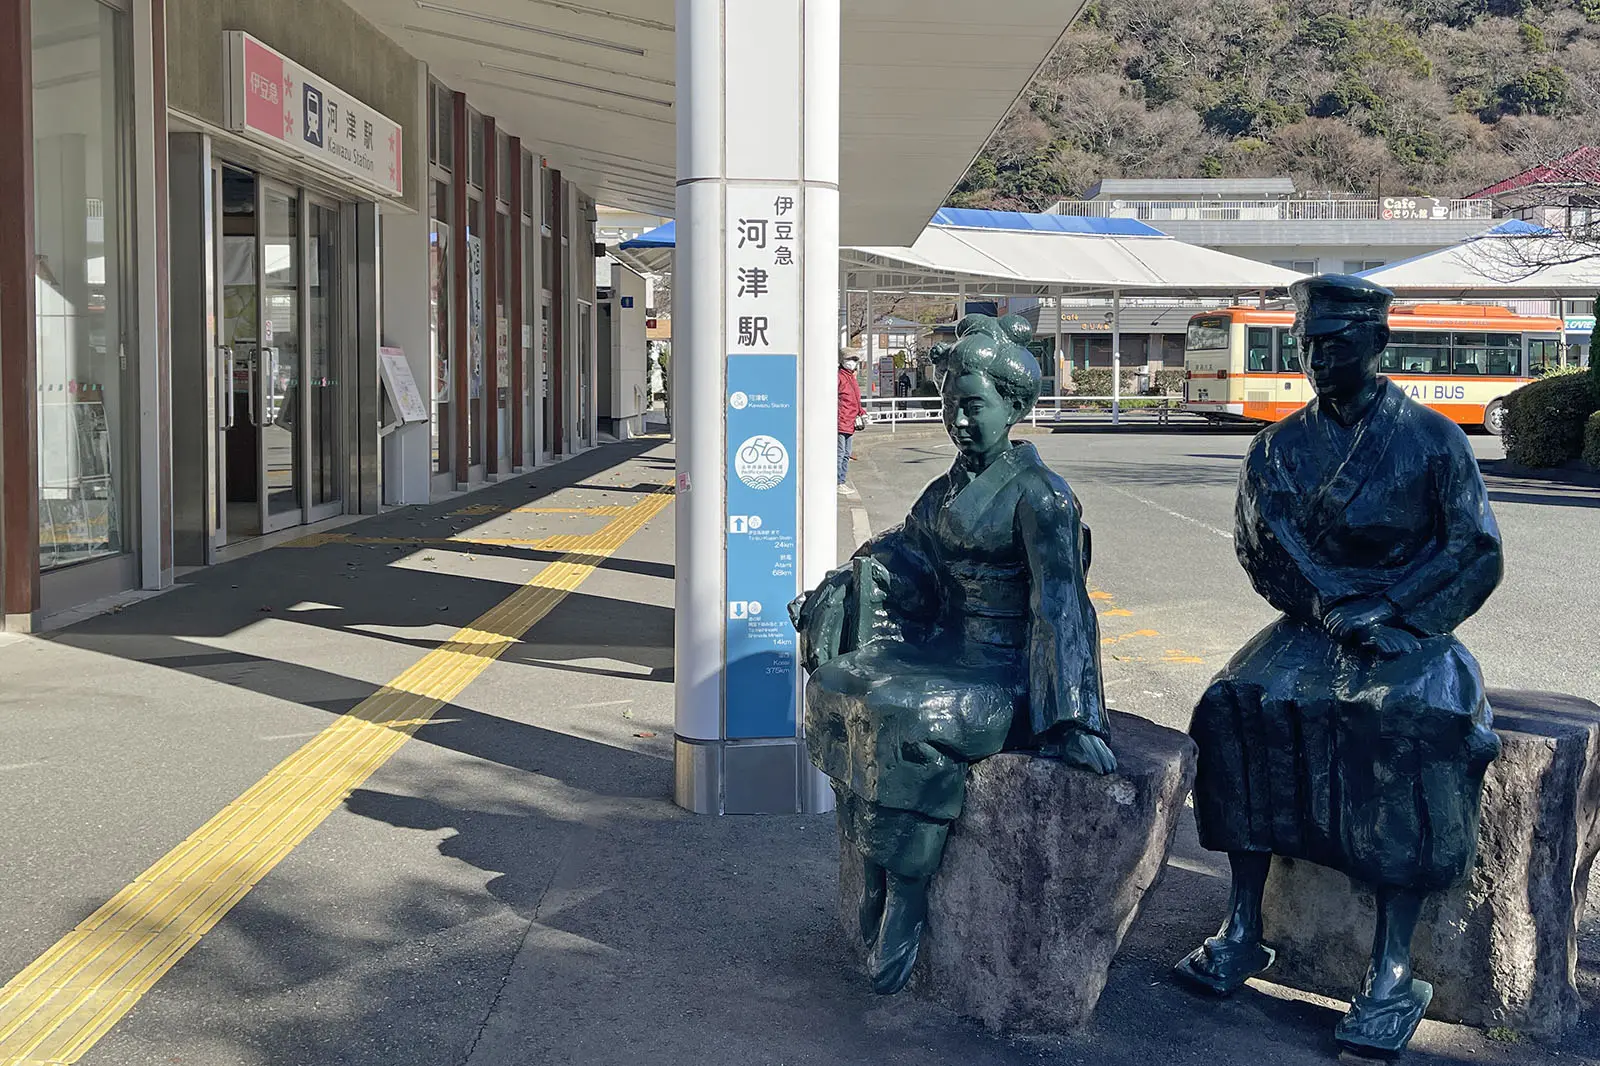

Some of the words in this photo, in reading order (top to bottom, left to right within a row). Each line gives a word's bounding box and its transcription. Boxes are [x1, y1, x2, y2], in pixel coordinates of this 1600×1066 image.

[250, 71, 279, 105] 伊豆急
[327, 99, 374, 151] 河津駅
[327, 136, 352, 161] Kawazu
[353, 148, 374, 172] Station
[1383, 198, 1416, 209] Cafe
[773, 195, 794, 266] 伊豆急
[737, 218, 769, 347] 河津駅
[1434, 385, 1465, 400] BUS
[774, 541, 794, 549] 24km
